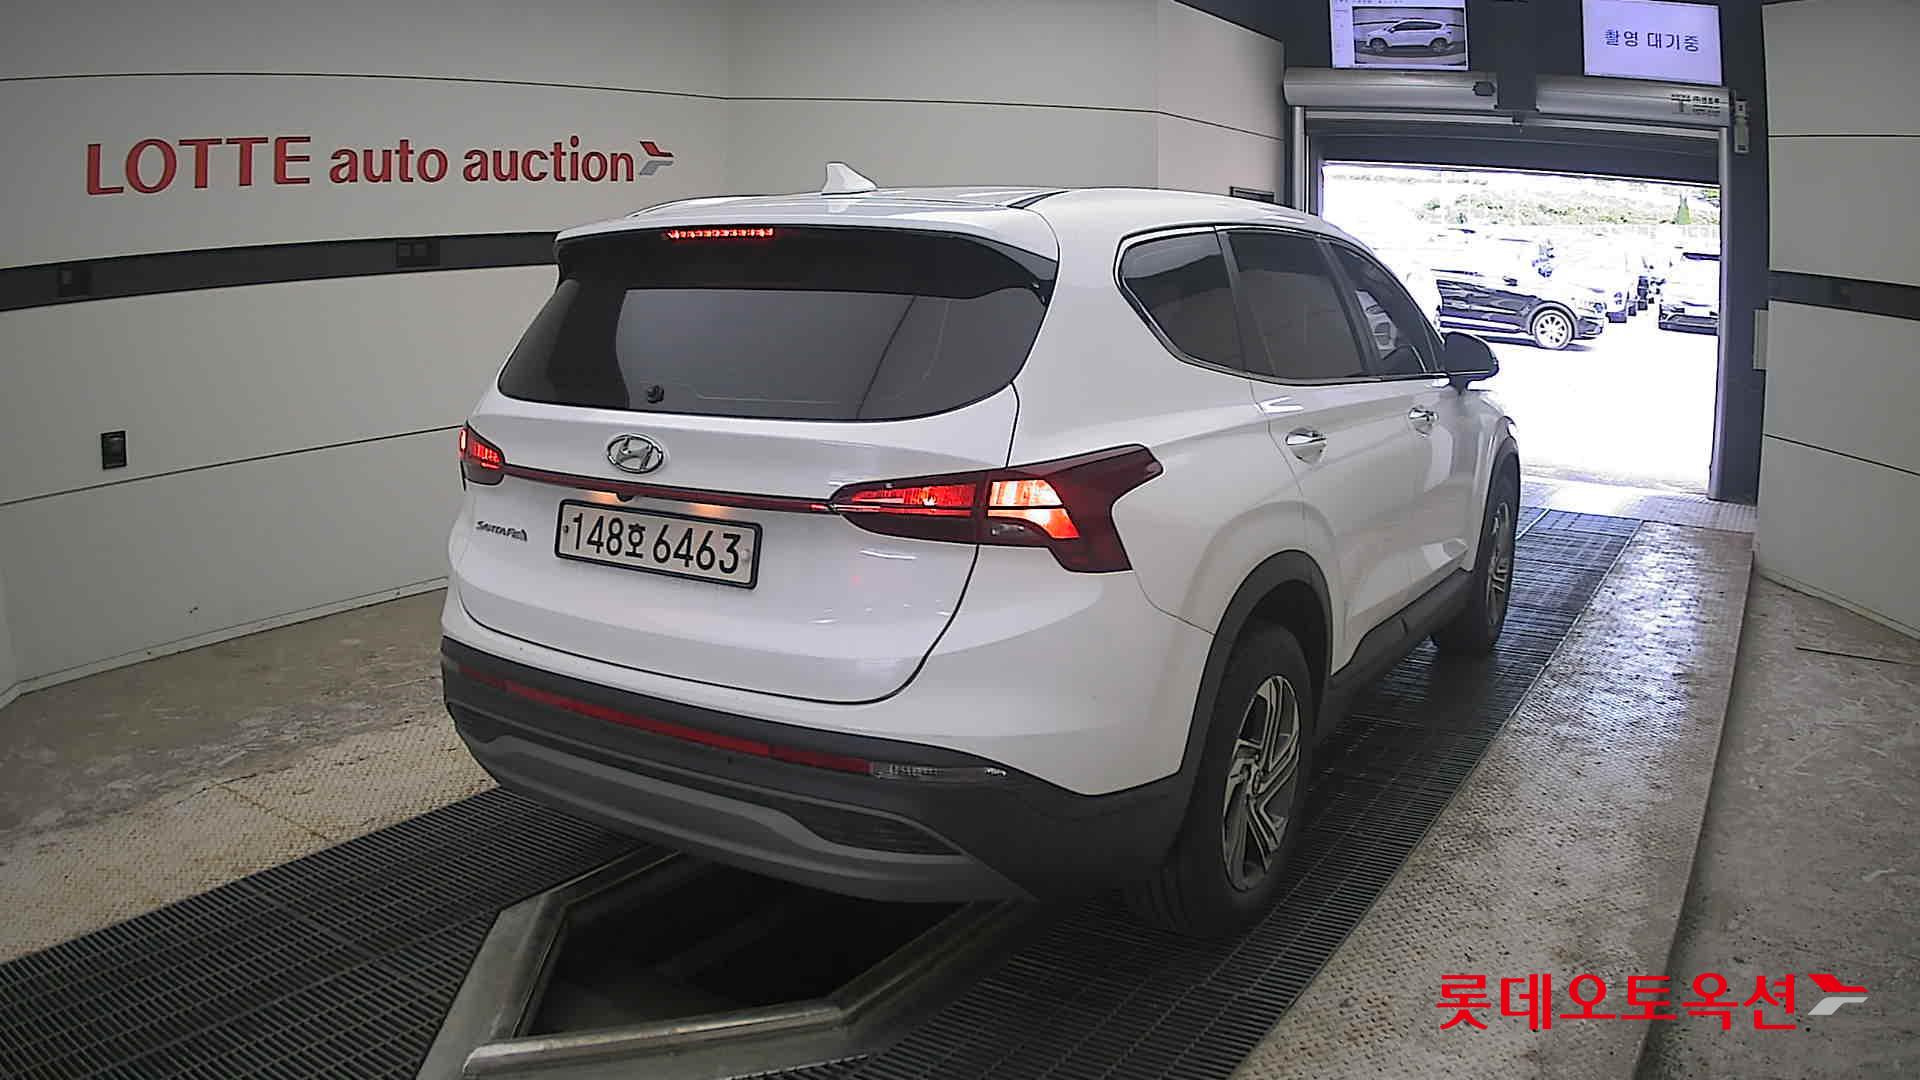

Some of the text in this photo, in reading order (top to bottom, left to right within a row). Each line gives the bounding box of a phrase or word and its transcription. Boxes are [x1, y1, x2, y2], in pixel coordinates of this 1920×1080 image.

[1647, 32, 1699, 52] 대기중
[87, 135, 635, 195] LOTTE auto auction
